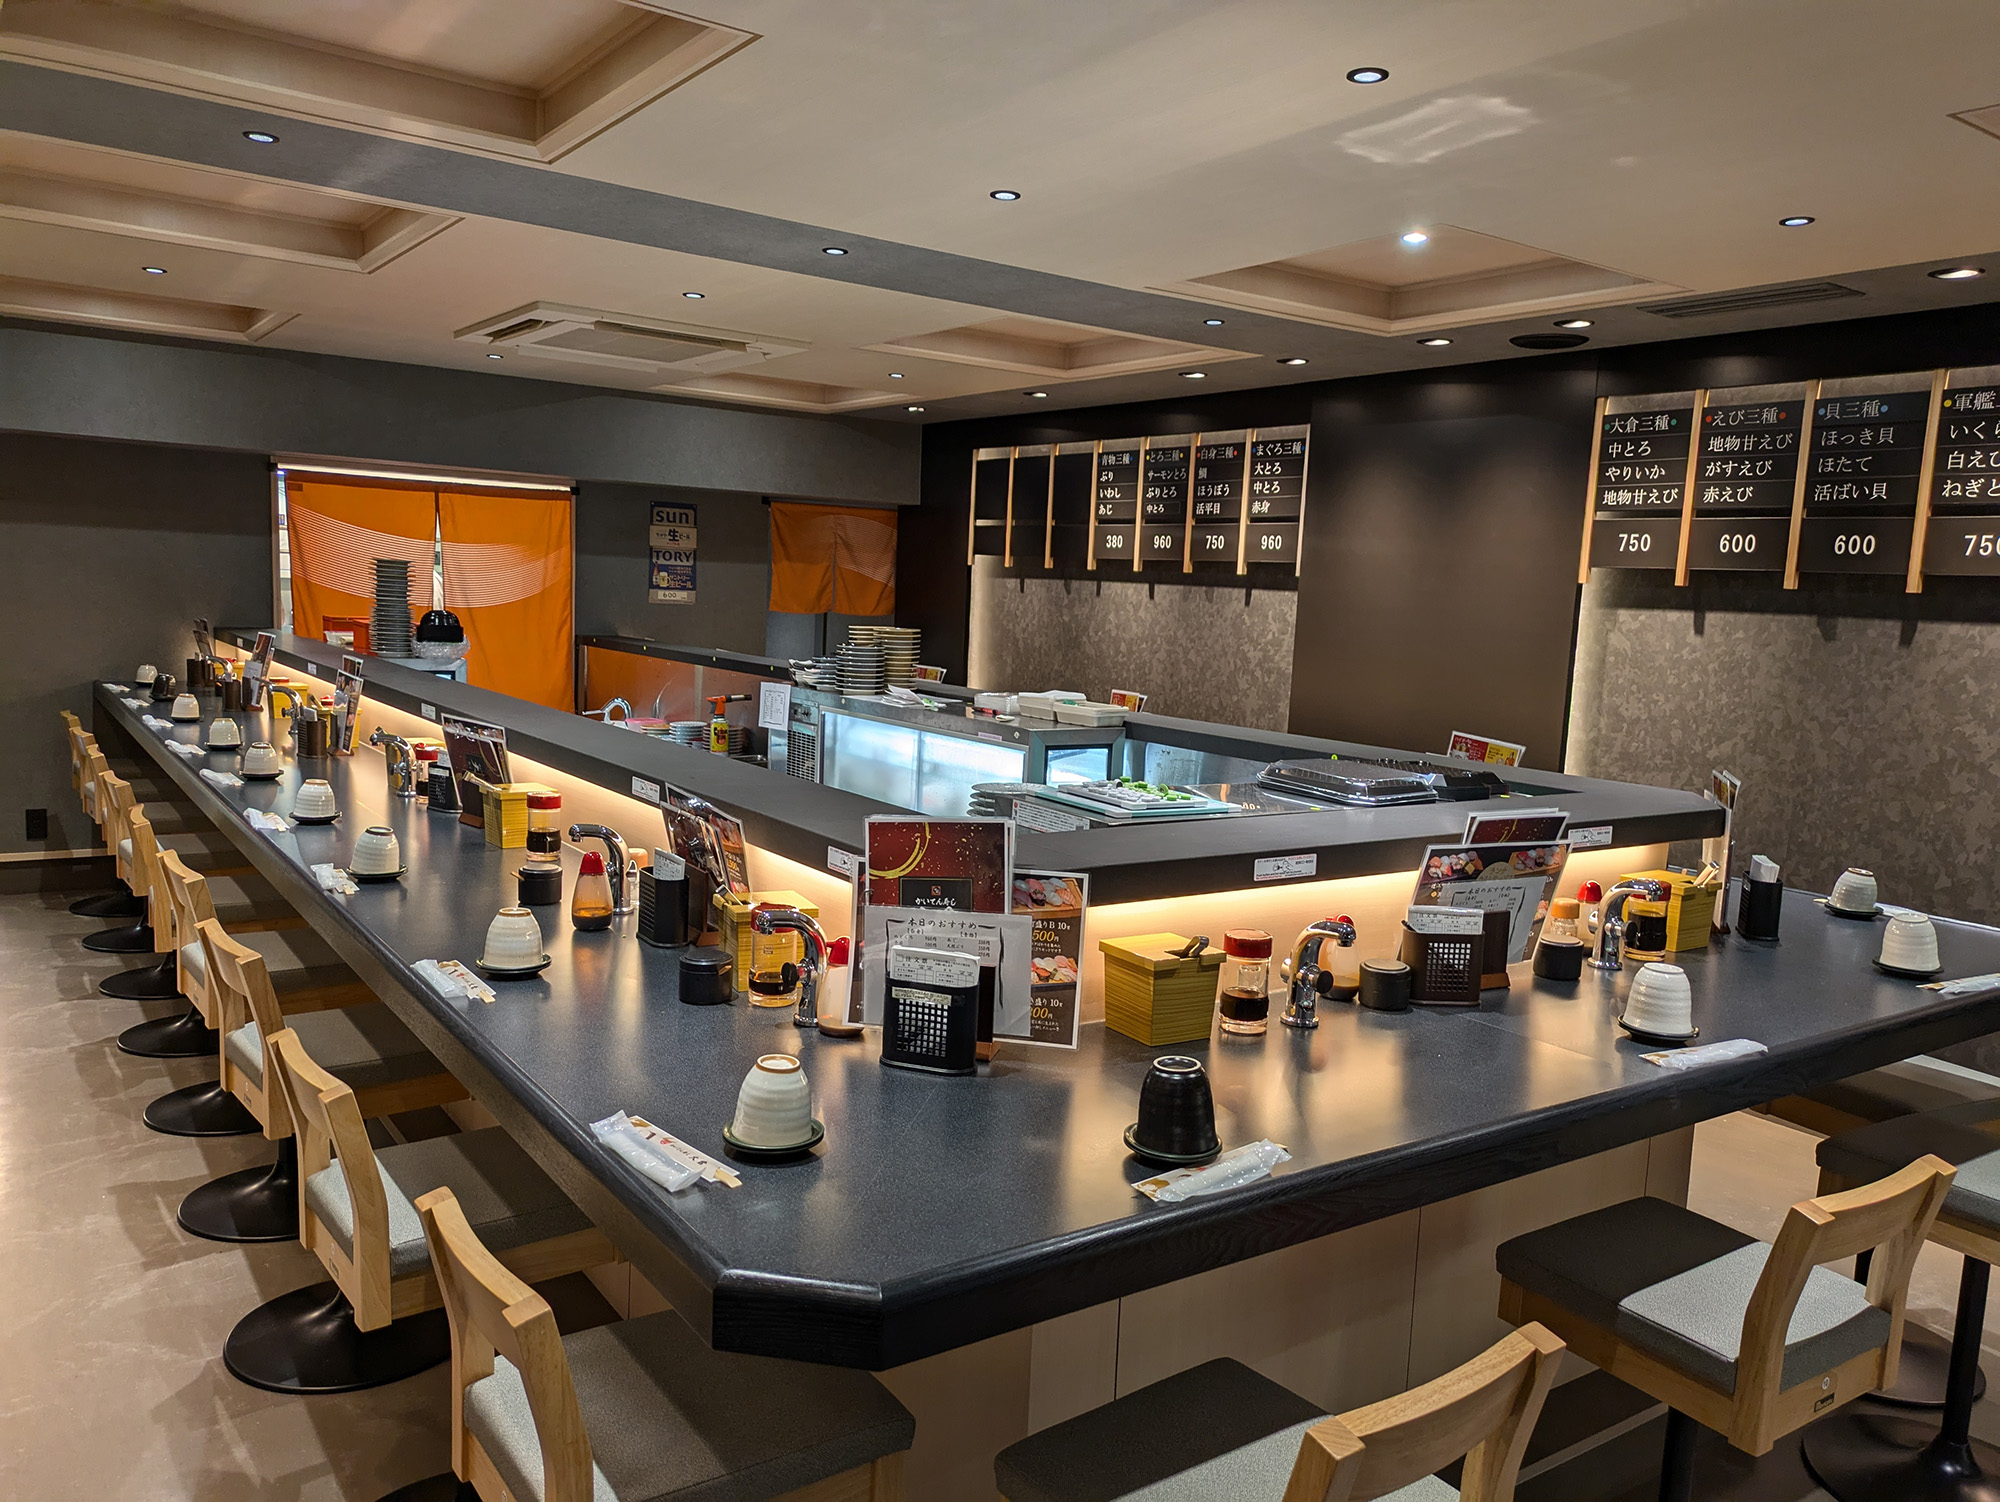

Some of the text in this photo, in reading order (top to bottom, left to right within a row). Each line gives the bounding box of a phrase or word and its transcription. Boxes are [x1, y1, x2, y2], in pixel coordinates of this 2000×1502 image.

[1952, 390, 2000, 412] 軍艦
[1712, 406, 1779, 426] えび三種
[1823, 399, 1881, 420] 貝三種
[1609, 414, 1669, 434] 大倉三種
[1708, 433, 1793, 452] 地物甘えび
[1821, 426, 1895, 446] ほっき貝
[1149, 449, 1180, 462] とろ三種
[1256, 441, 1302, 456] まぐろ三種
[1608, 440, 1651, 459] 中とろ
[1254, 461, 1282, 475] 大とろ
[1705, 459, 1773, 477] がすえび
[1818, 455, 1873, 473] ほたて
[1100, 471, 1114, 482] ぶり
[1147, 468, 1187, 481] サーモンとろ
[1605, 464, 1666, 482] やりいか
[1099, 487, 1121, 498] いわし
[1145, 486, 1177, 498] ぶりとろ
[1197, 483, 1230, 497] ほうぼう
[1253, 481, 1281, 494] 中とろ
[1703, 485, 1753, 504] 赤えび
[1814, 482, 1887, 501] 活ばい貝
[1602, 487, 1679, 505] 地物甘えび
[1098, 504, 1113, 515] あじ
[1146, 503, 1165, 514] 中とろ
[1195, 502, 1221, 515] 活平目
[1252, 500, 1271, 514] 赤身
[668, 528, 680, 542] 生
[1105, 534, 1123, 548] 380
[1153, 535, 1172, 549] 960
[1205, 534, 1225, 550] 750
[1260, 534, 1282, 550] 960
[1618, 533, 1651, 552] 750
[1719, 533, 1757, 553] 600
[1834, 534, 1876, 555] 600
[653, 550, 693, 563] TORY
[908, 917, 977, 930] 本日のおすすめ
